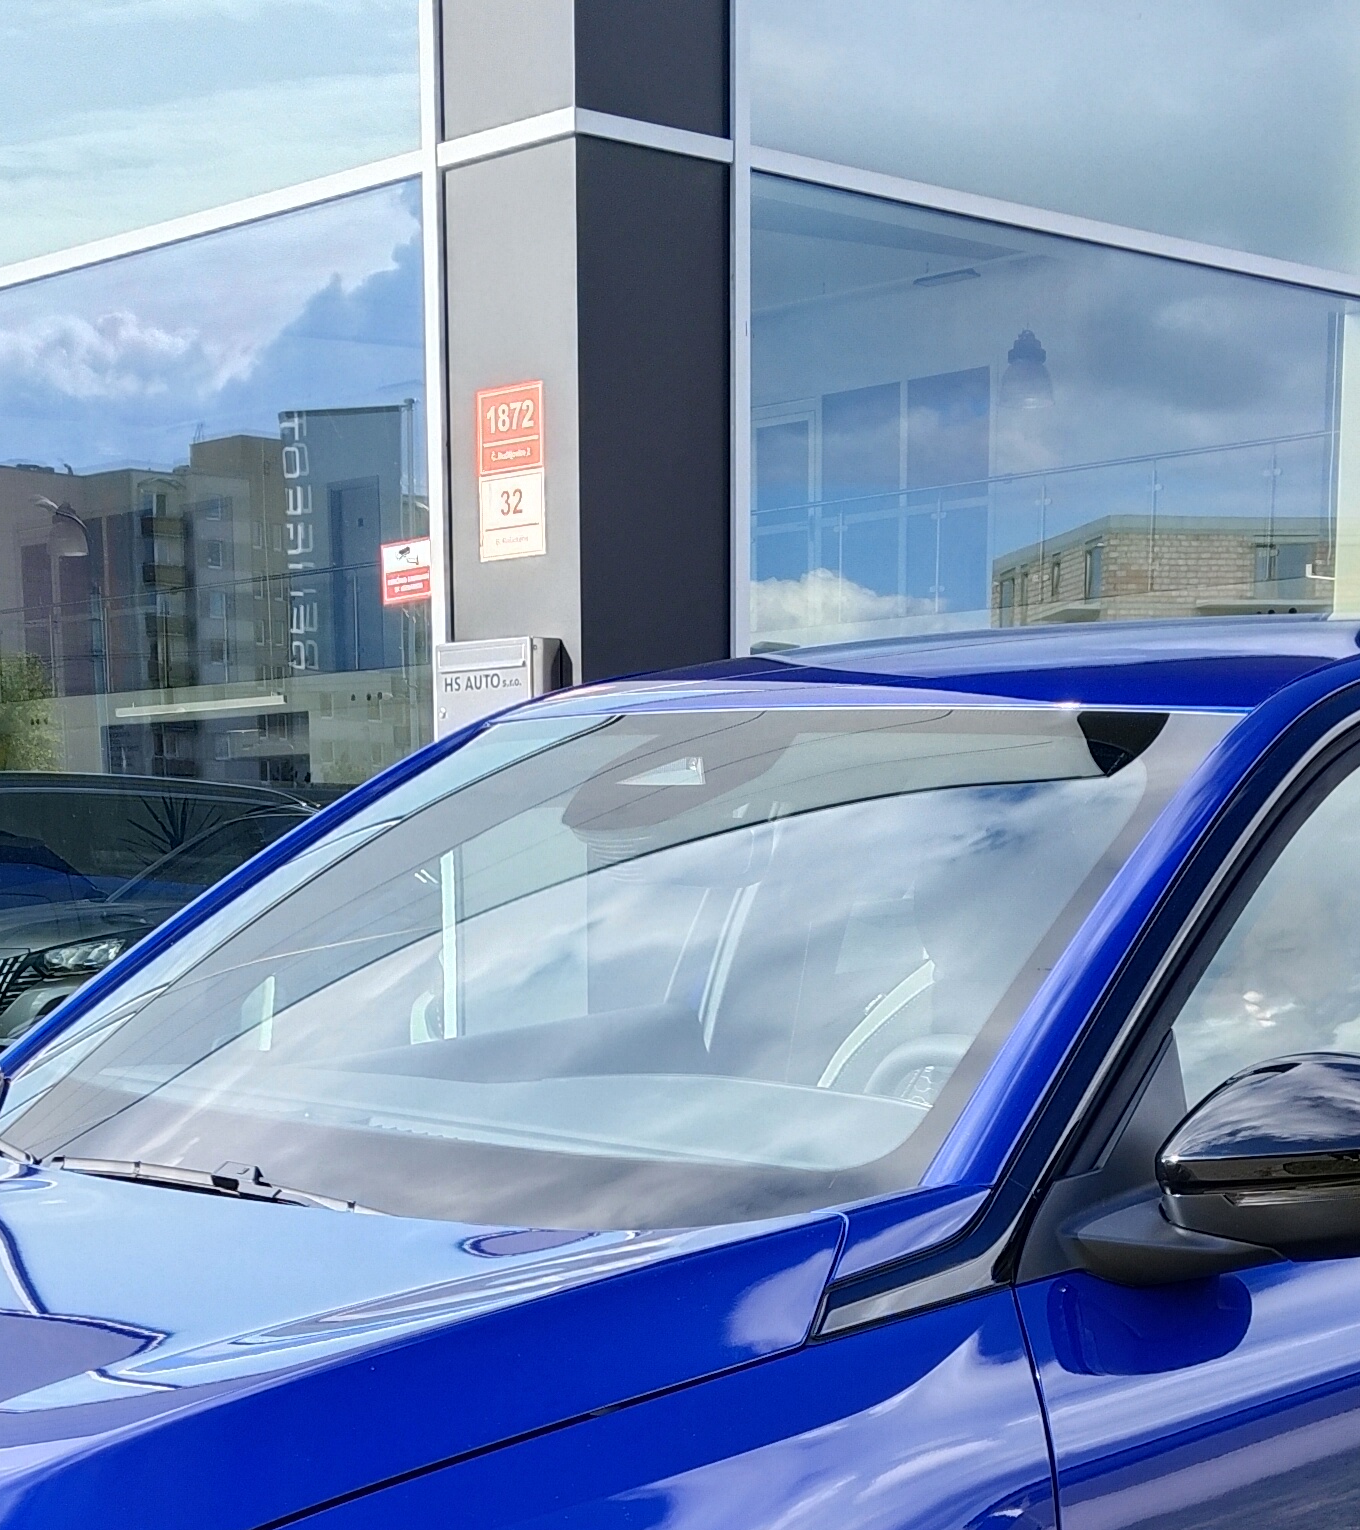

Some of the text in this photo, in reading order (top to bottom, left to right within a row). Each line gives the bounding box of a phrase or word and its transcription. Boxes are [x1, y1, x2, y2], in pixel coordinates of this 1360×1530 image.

[486, 399, 535, 434] 1872
[500, 488, 523, 516] 32
[444, 673, 522, 693] HS AUTO s.r.o.
